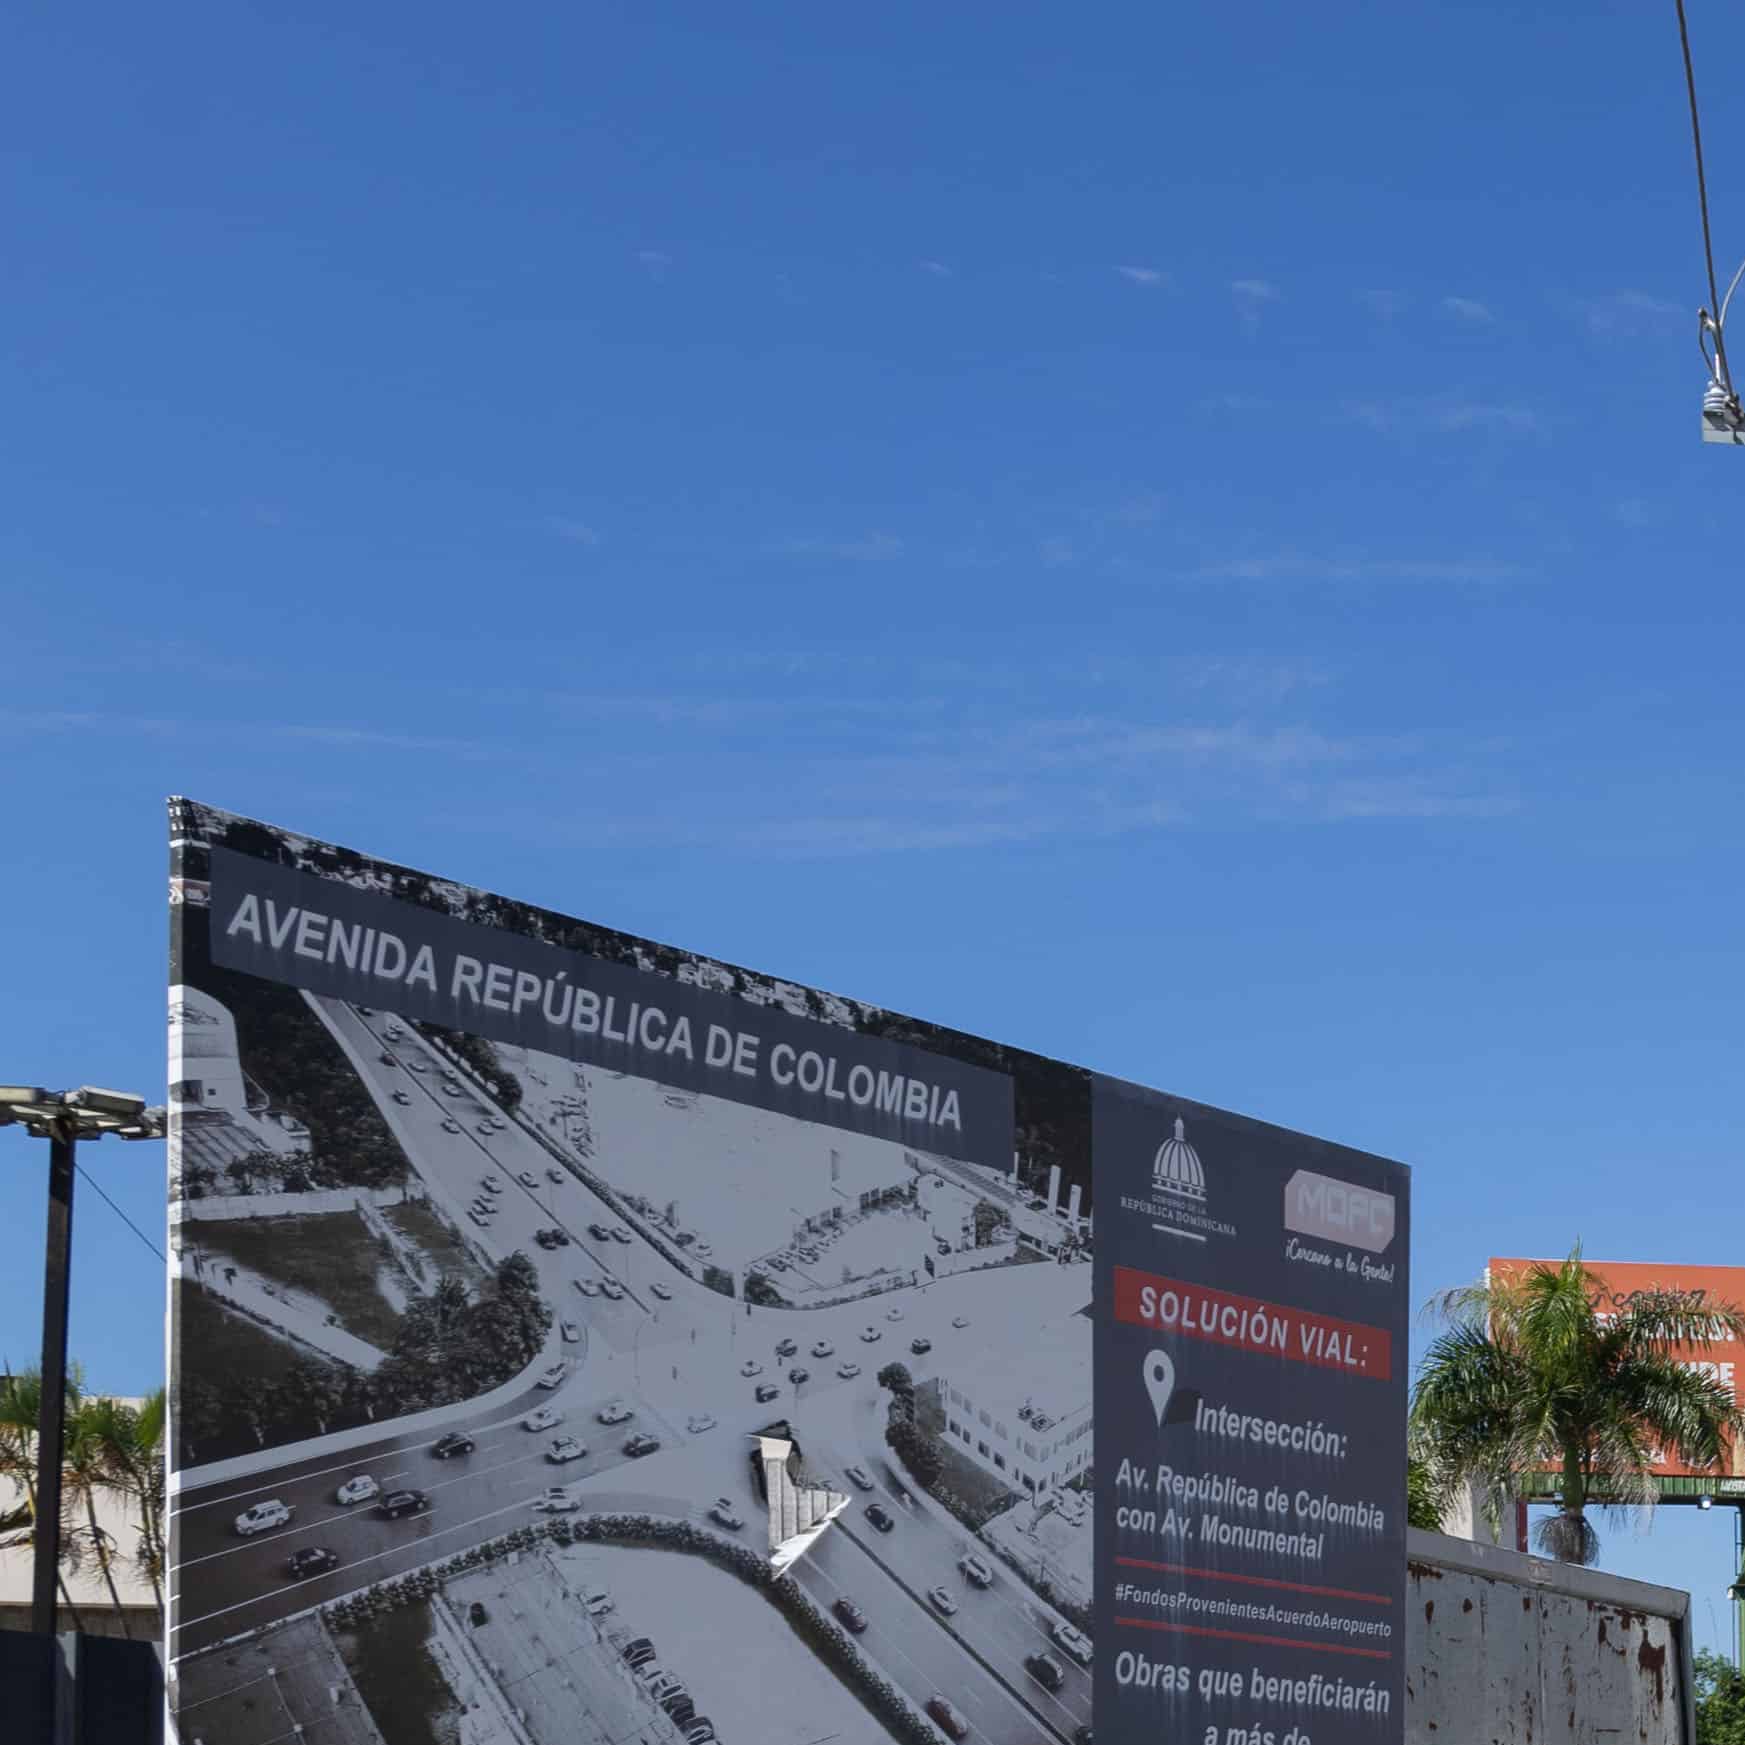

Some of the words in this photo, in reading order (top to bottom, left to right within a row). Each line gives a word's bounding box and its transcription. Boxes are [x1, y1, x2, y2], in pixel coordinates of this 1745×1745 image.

[226, 894, 438, 992] AVENIDA
[451, 954, 695, 1060] REPÚBLICA
[704, 1023, 760, 1077] DE
[770, 1043, 962, 1131] COLOMBIA
[1119, 1196, 1174, 1221] REPÚBLICA
[1175, 1210, 1238, 1237] DOMINICANA
[1296, 1183, 1392, 1233] MOPC
[1345, 1251, 1360, 1273] la
[1139, 1286, 1289, 1350] SOLUCIÓN
[1300, 1322, 1368, 1368] VIAL:
[1194, 1398, 1348, 1459] Intersección:
[1115, 1458, 1149, 1490] Av.
[1156, 1464, 1259, 1513] República
[1264, 1486, 1290, 1513] de
[1295, 1490, 1385, 1533] Colombia
[1116, 1506, 1156, 1531] con
[1160, 1508, 1193, 1539] Av.
[1200, 1514, 1325, 1560] Monumental
[1115, 1583, 1393, 1638] #FondosProvenientesAcuerdoAeropuerto
[1115, 1651, 1191, 1693] Obras
[1198, 1668, 1243, 1702] que
[1250, 1667, 1391, 1714] beneficiarán
